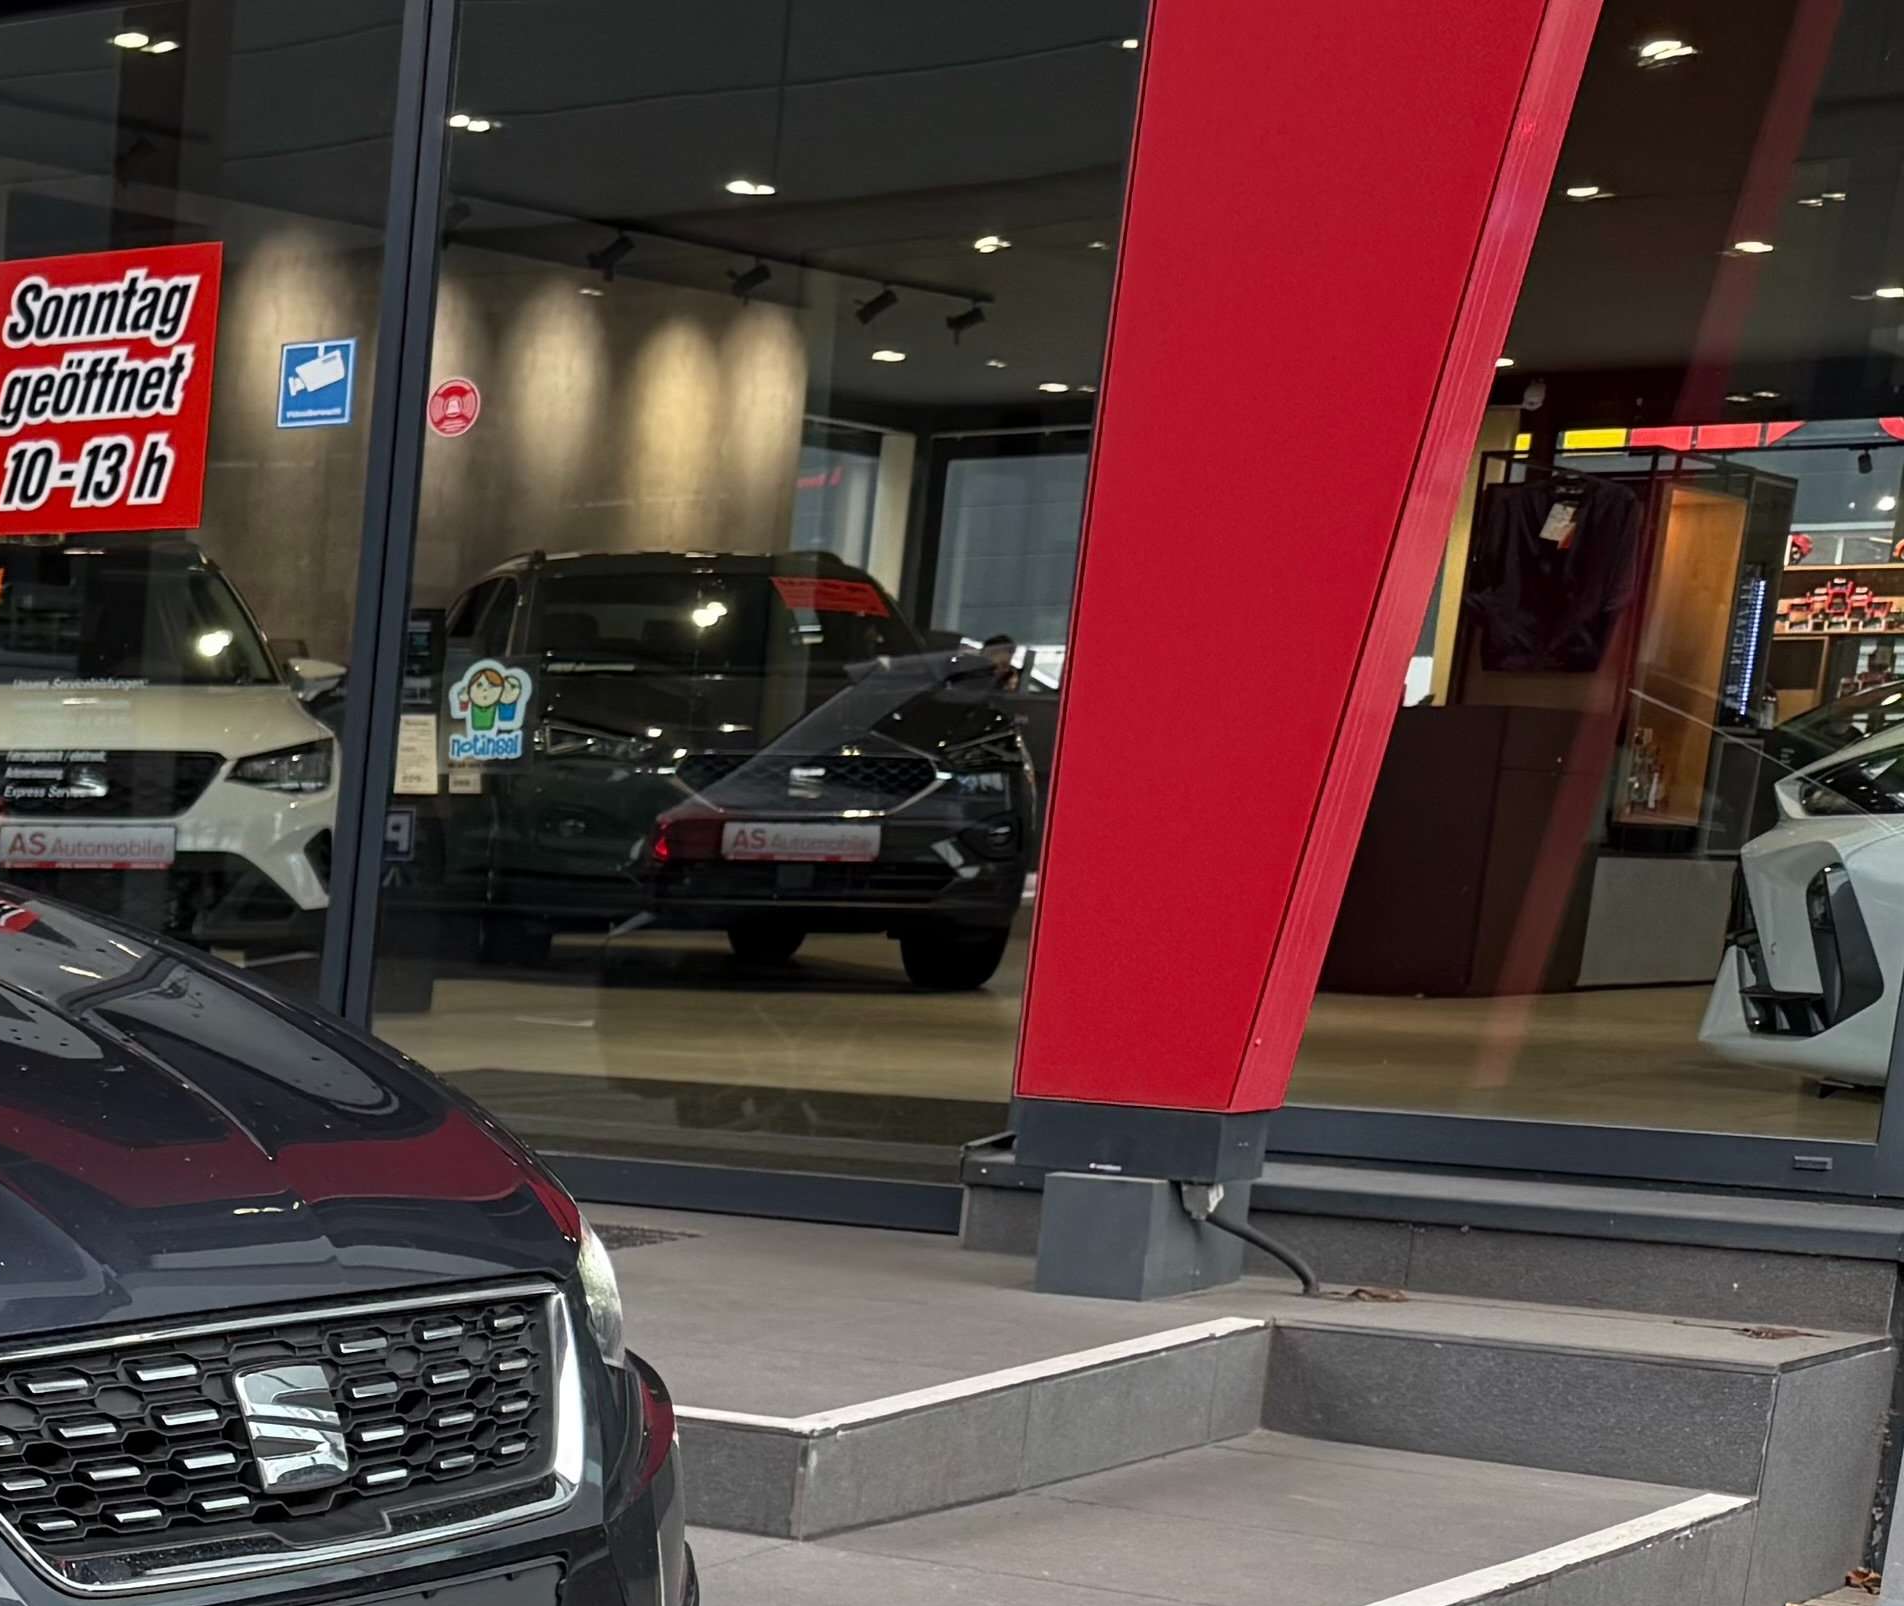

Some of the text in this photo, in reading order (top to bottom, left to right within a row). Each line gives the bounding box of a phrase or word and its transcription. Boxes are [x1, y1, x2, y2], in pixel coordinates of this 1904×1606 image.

[5, 273, 193, 343] Sonntag
[133, 439, 169, 500] h
[7, 832, 166, 857] AS Automobile
[732, 827, 768, 849] AS
